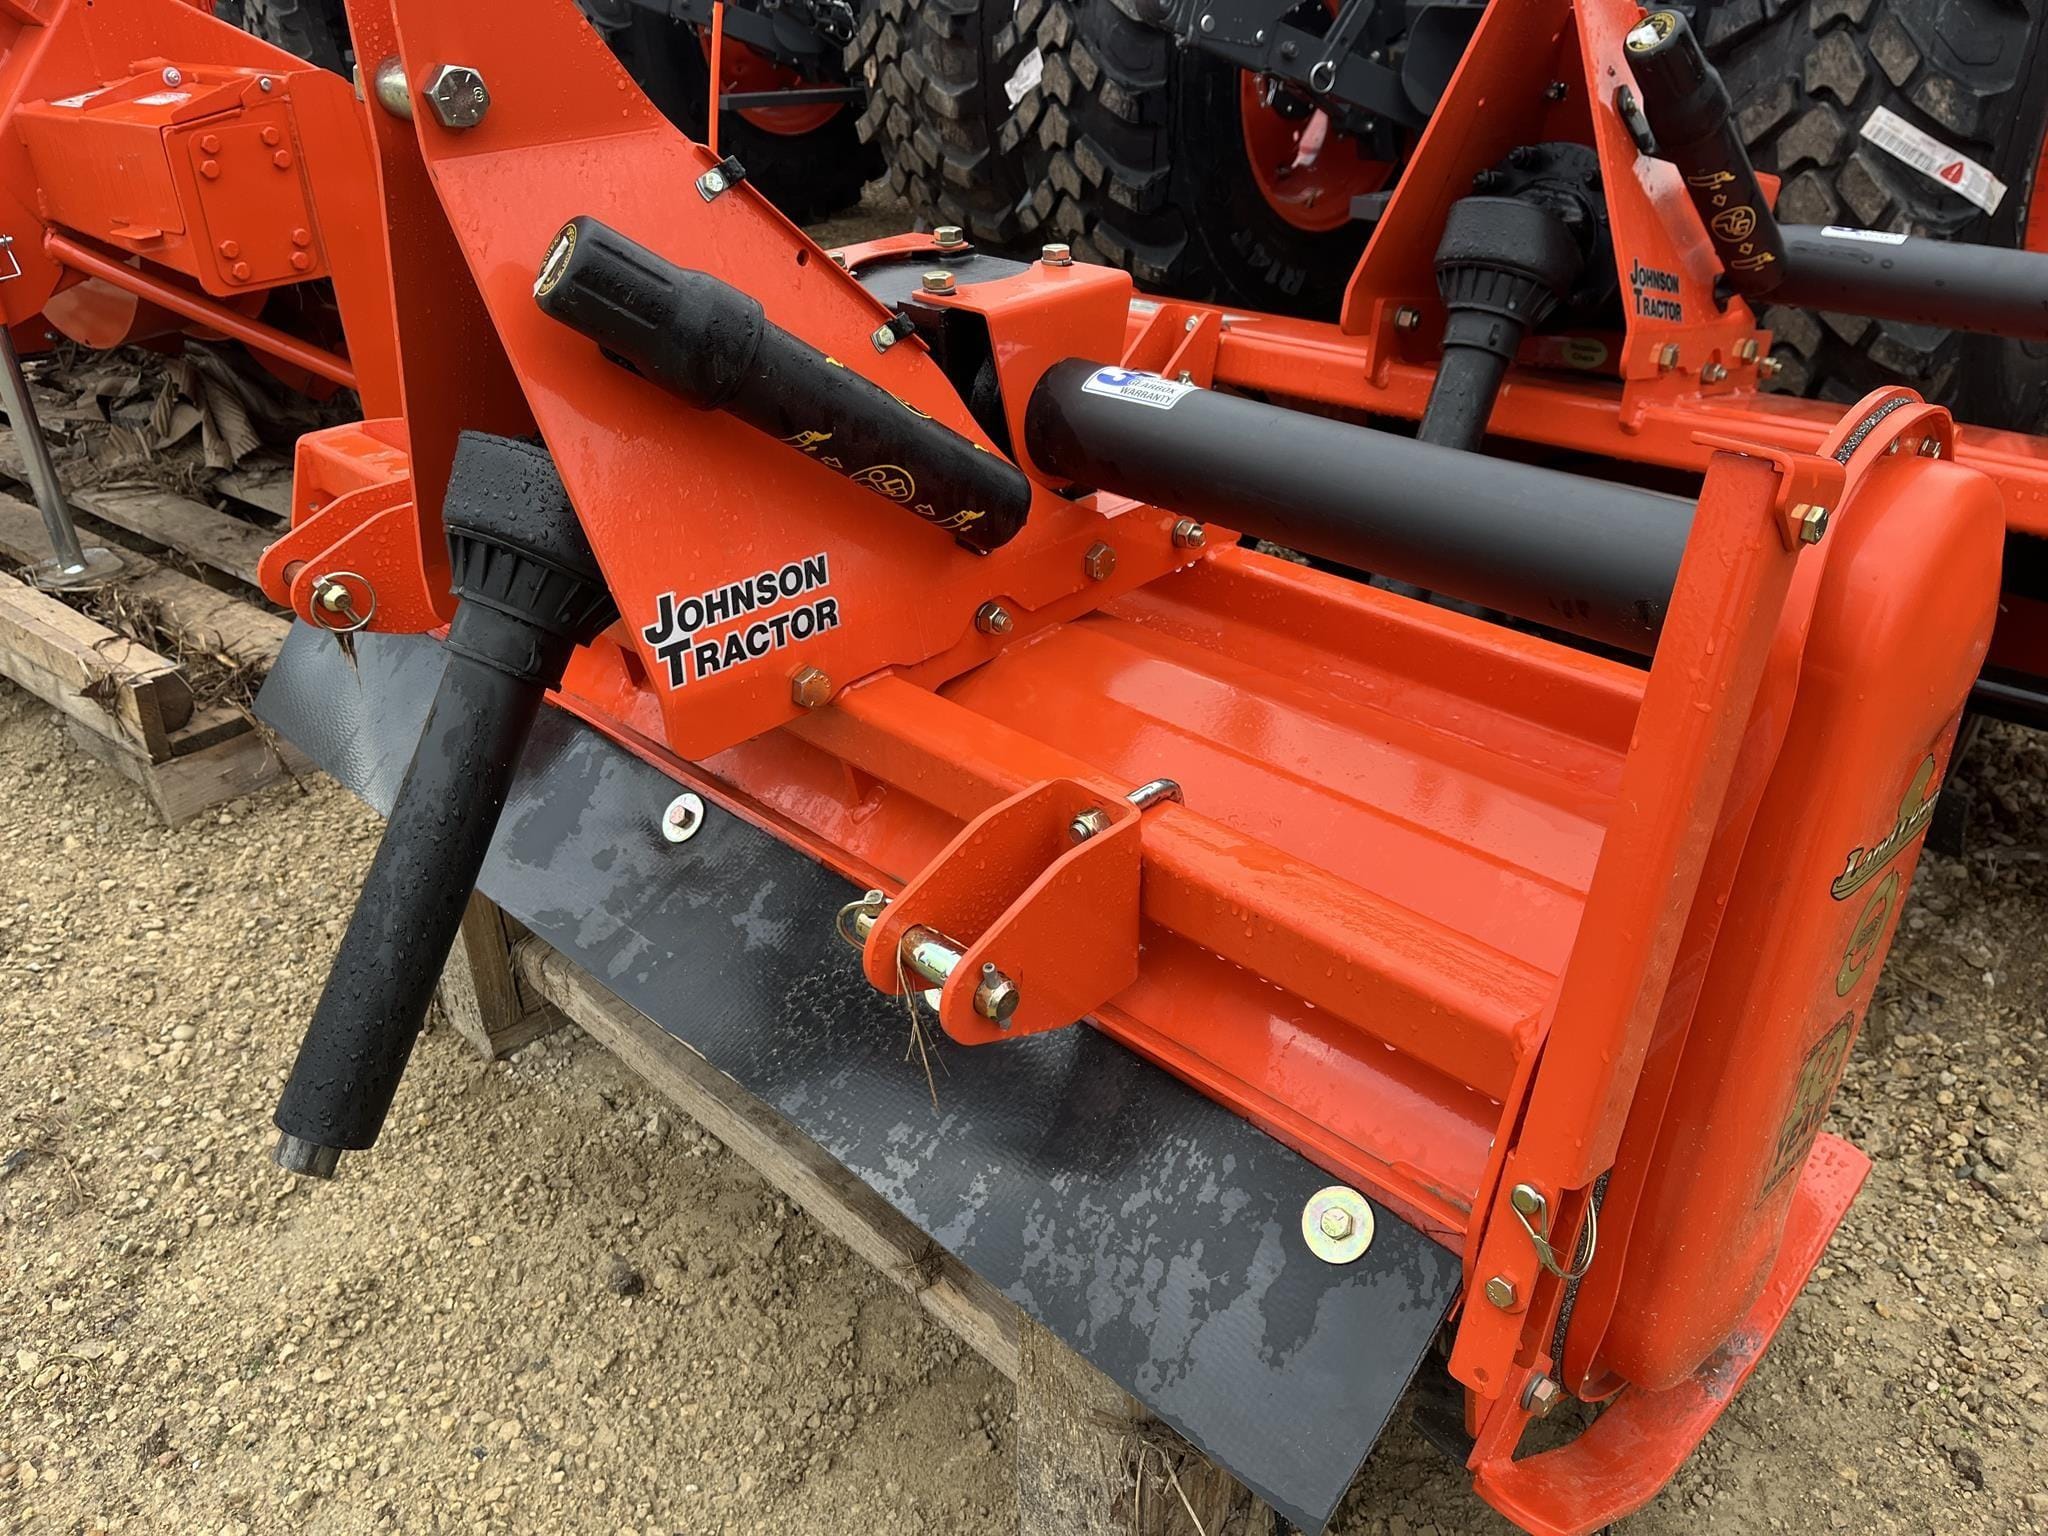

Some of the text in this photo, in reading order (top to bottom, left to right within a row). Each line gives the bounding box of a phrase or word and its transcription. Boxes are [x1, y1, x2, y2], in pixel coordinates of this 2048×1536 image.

[1629, 257, 1680, 294] JOHNSON
[1633, 286, 1683, 323] TRACTOR
[1119, 386, 1173, 404] WARRANTY
[1128, 379, 1176, 395] GEARBOX
[643, 553, 828, 646] JOHNSON
[657, 597, 839, 689] TRACTOR
